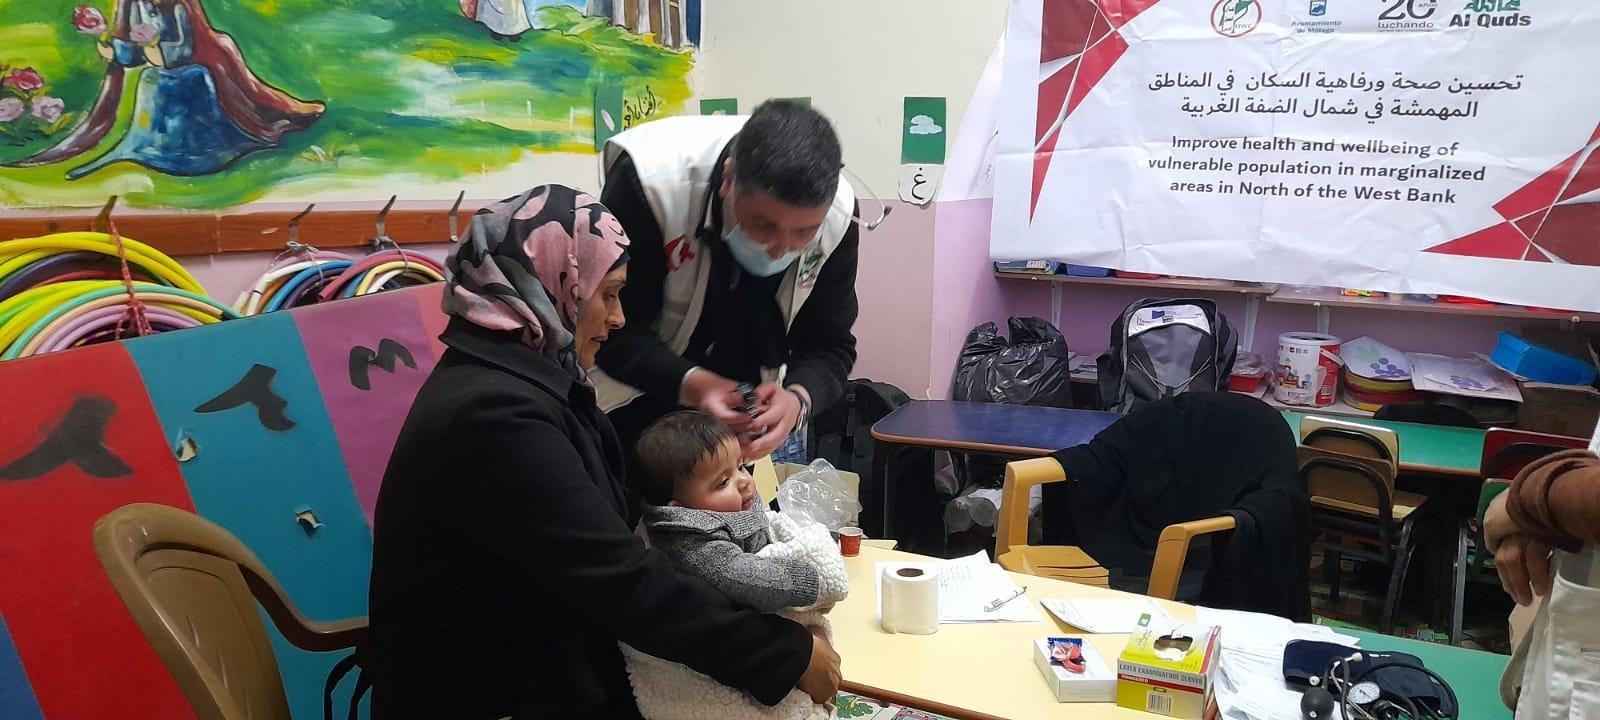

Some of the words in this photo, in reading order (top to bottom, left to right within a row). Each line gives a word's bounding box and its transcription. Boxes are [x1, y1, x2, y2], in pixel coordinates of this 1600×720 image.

[1449, 13, 1471, 27] Al
[1477, 12, 1532, 28] Quds
[1148, 71, 1213, 91] المناطق
[1217, 69, 1235, 96] في
[1245, 71, 1311, 91] السكان
[1315, 71, 1385, 93] ورفاهية
[1391, 71, 1441, 90] صحة
[1447, 74, 1524, 95] تحسين
[1181, 96, 1240, 118] الغربية
[1244, 97, 1298, 114] الضفة
[1303, 98, 1359, 118] شمال
[1364, 97, 1384, 124] في
[1390, 98, 1479, 121] المهمشة
[1172, 135, 1238, 151] Improve
[1242, 136, 1296, 151] health
[1301, 138, 1335, 152] and
[1341, 139, 1432, 159] wellbeing
[1436, 142, 1459, 156] of
[1148, 156, 1233, 171] vulnerable
[1237, 159, 1332, 176] population
[1338, 161, 1354, 176] in
[1360, 164, 1486, 181] marginalized
[1170, 181, 1214, 193] areas
[1218, 180, 1234, 194] in
[1239, 181, 1289, 197] North
[1294, 183, 1314, 198] of
[1318, 184, 1348, 199] the
[1354, 185, 1401, 201] West
[1407, 187, 1456, 204] Bank
